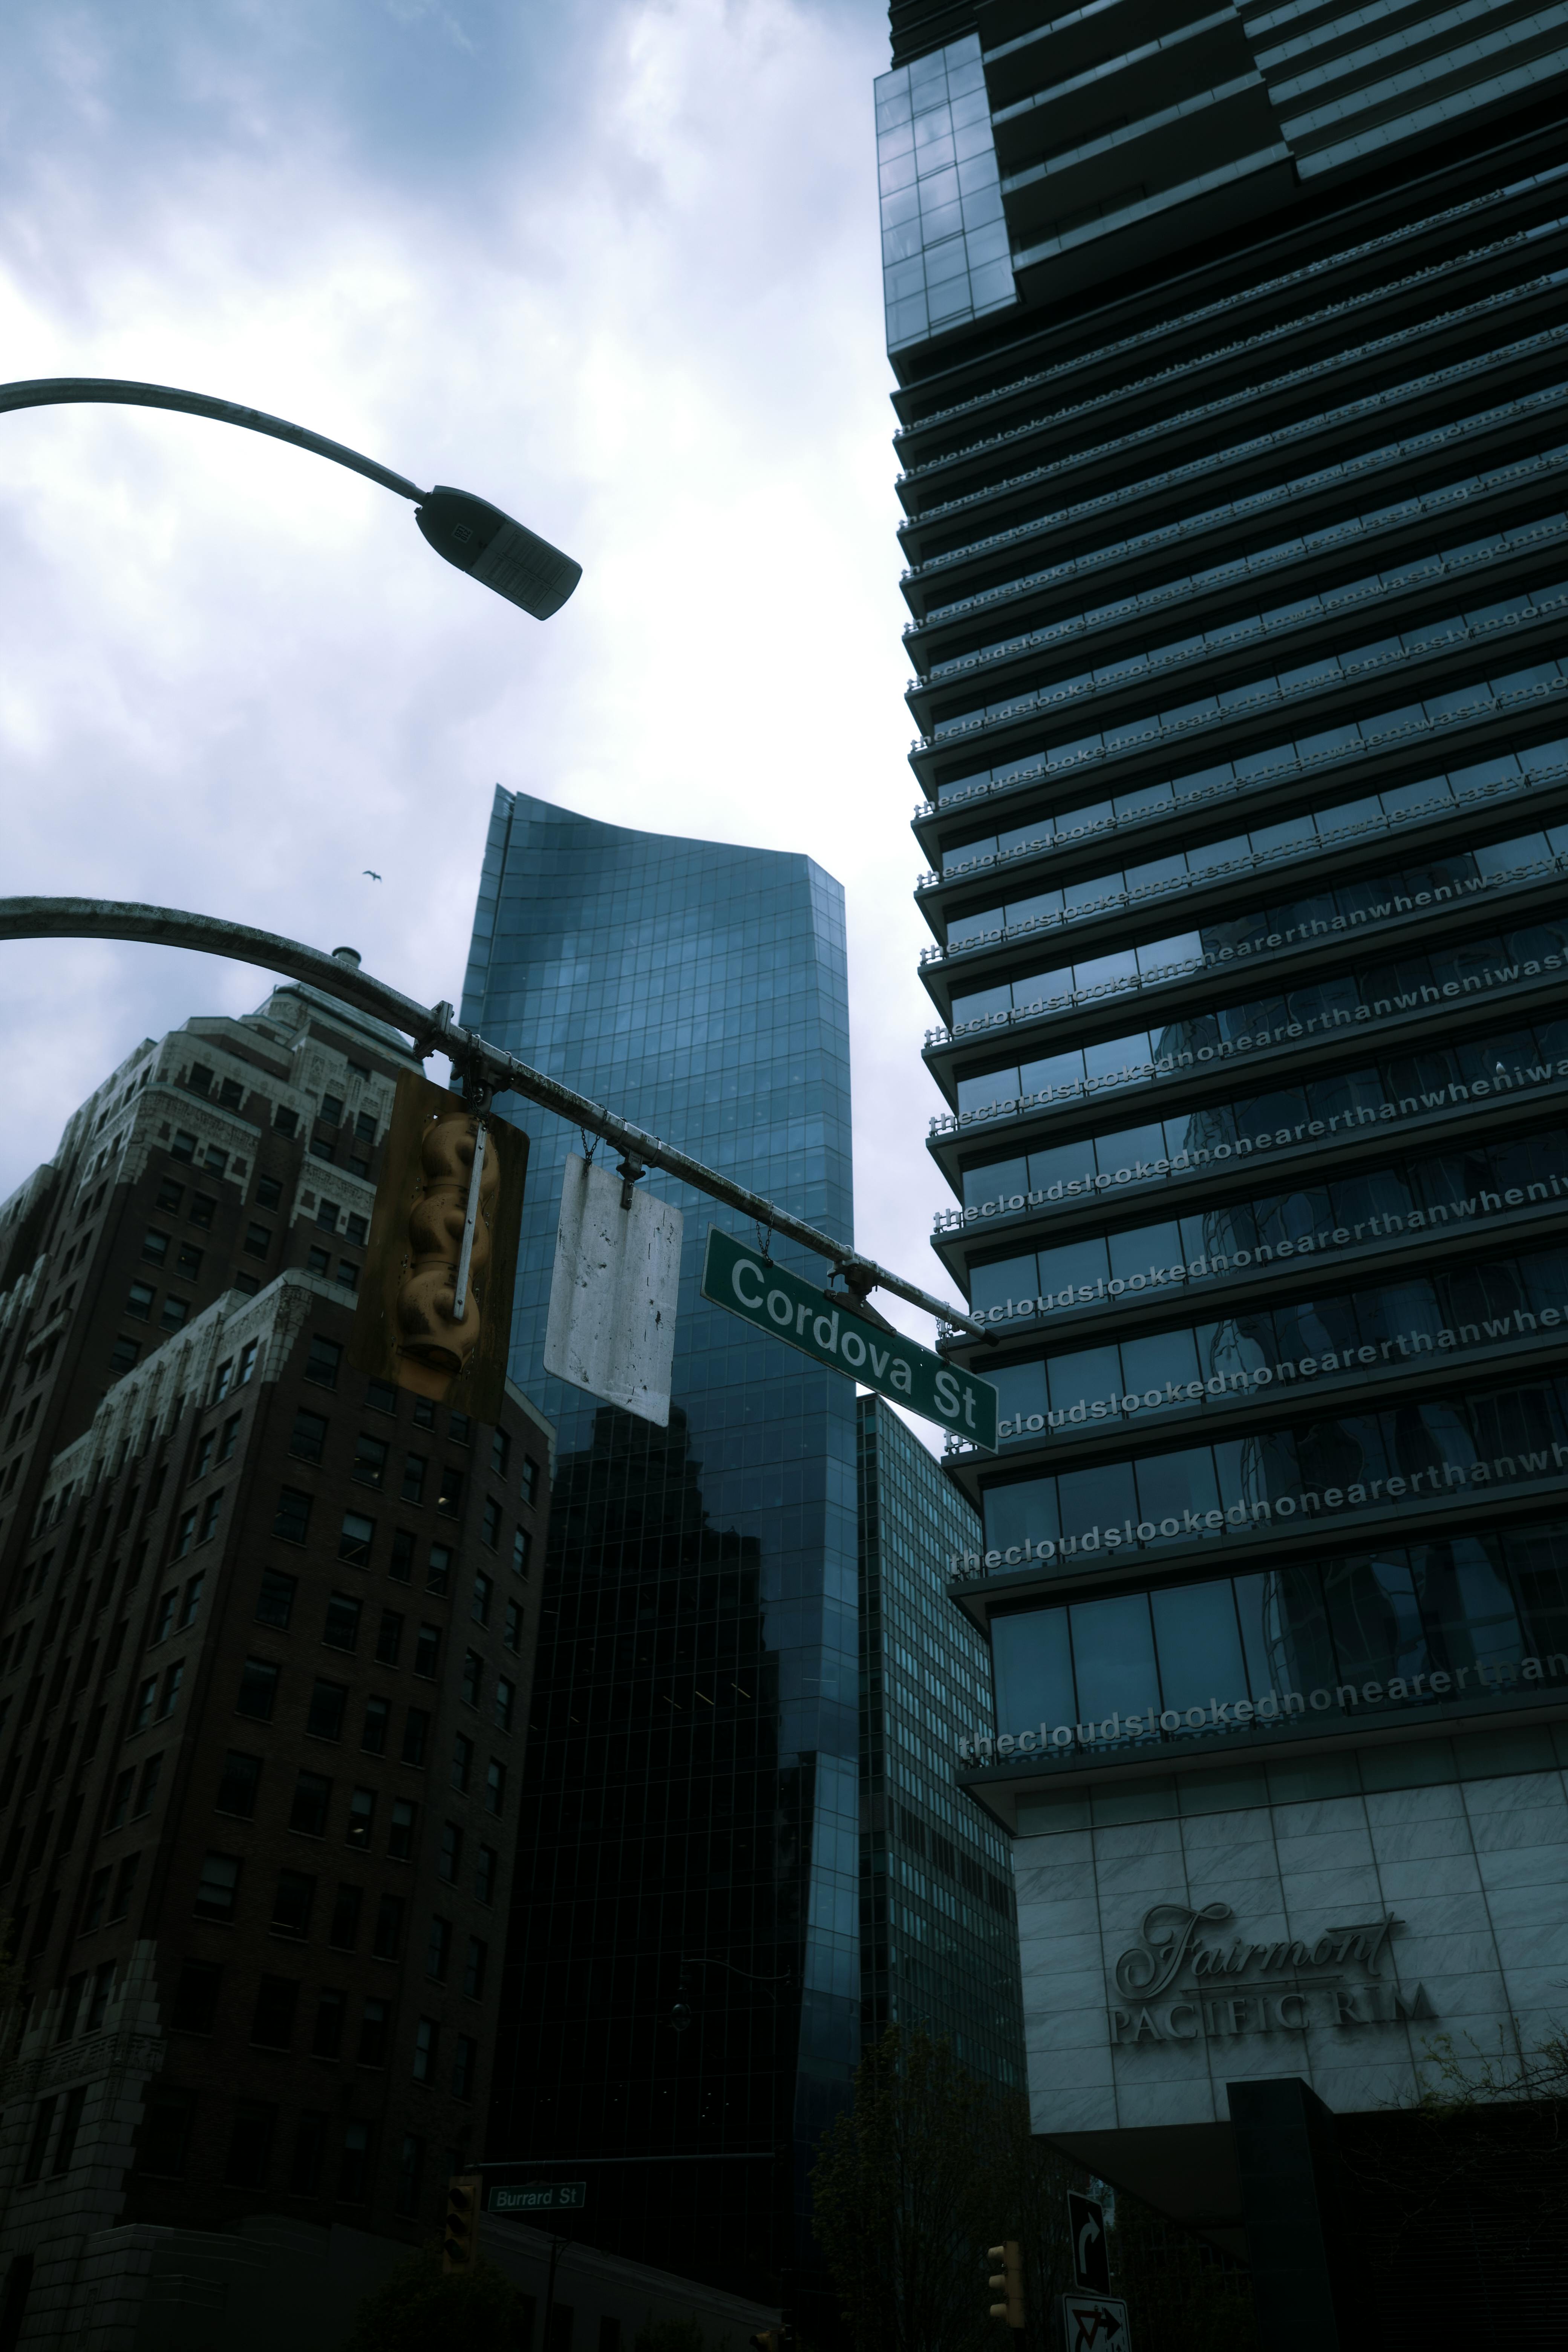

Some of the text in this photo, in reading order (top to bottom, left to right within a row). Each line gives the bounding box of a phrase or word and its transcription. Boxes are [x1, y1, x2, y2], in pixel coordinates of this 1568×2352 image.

[455, 525, 465, 537] LED
[461, 530, 471, 541] 210
[732, 1259, 976, 1429] Cordova St
[1115, 1902, 1406, 2000] Fairmont
[1107, 1981, 1439, 2046] PACIFIC RIM
[496, 2187, 577, 2207] Burrard St
